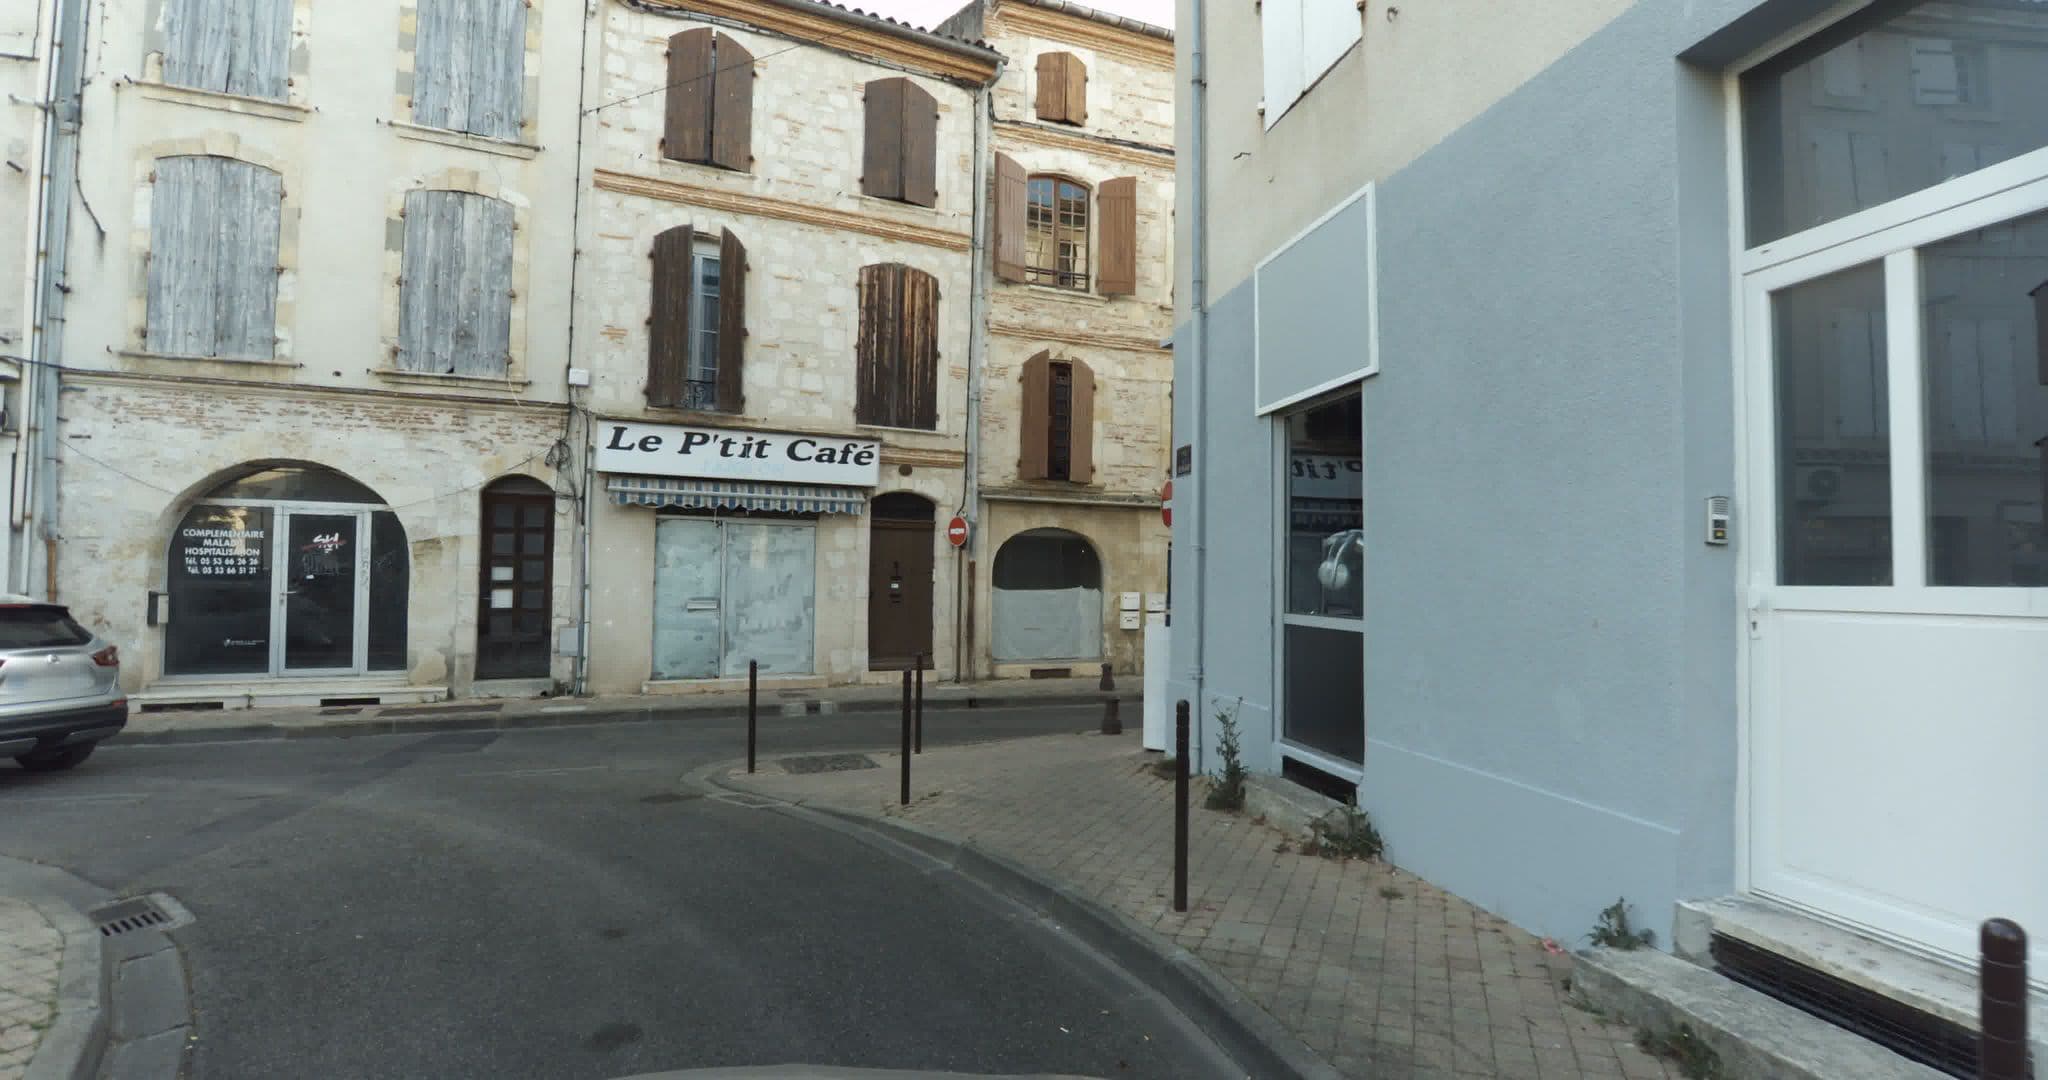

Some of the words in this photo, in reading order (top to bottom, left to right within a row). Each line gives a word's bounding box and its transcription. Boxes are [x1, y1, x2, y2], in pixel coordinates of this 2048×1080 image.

[605, 426, 664, 453] Le
[676, 431, 772, 460] P'tit
[786, 439, 876, 467] Café
[183, 528, 265, 539] COMPLEMENTAIRE
[225, 558, 235, 566] 66
